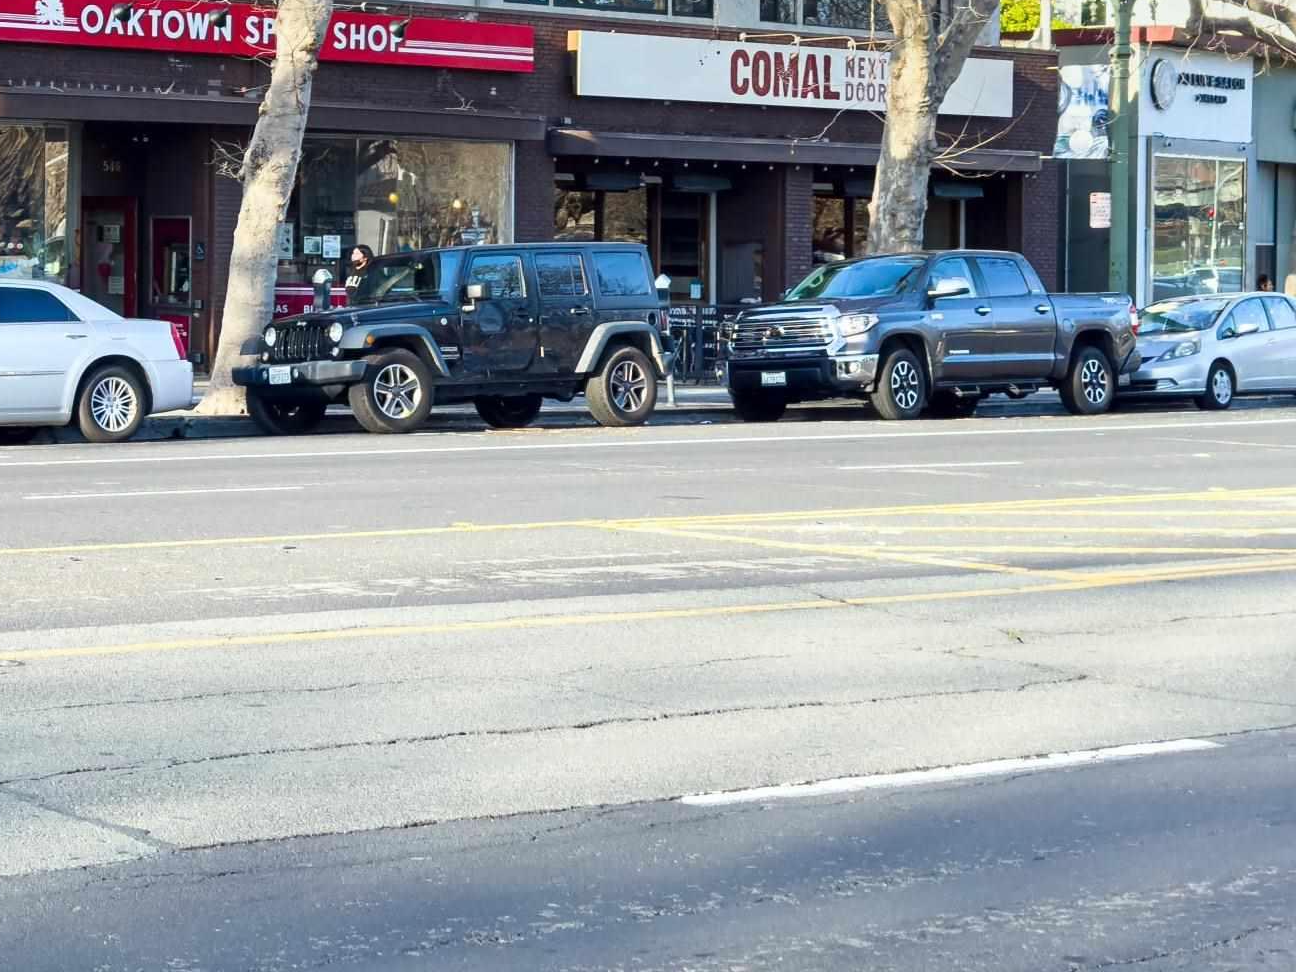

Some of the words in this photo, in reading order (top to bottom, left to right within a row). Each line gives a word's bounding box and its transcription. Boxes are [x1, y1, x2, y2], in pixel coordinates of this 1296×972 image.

[80, 4, 232, 41] OAKTOWN
[730, 49, 840, 101] COMAL
[845, 56, 887, 80] NEXT
[845, 81, 887, 103] DOOR
